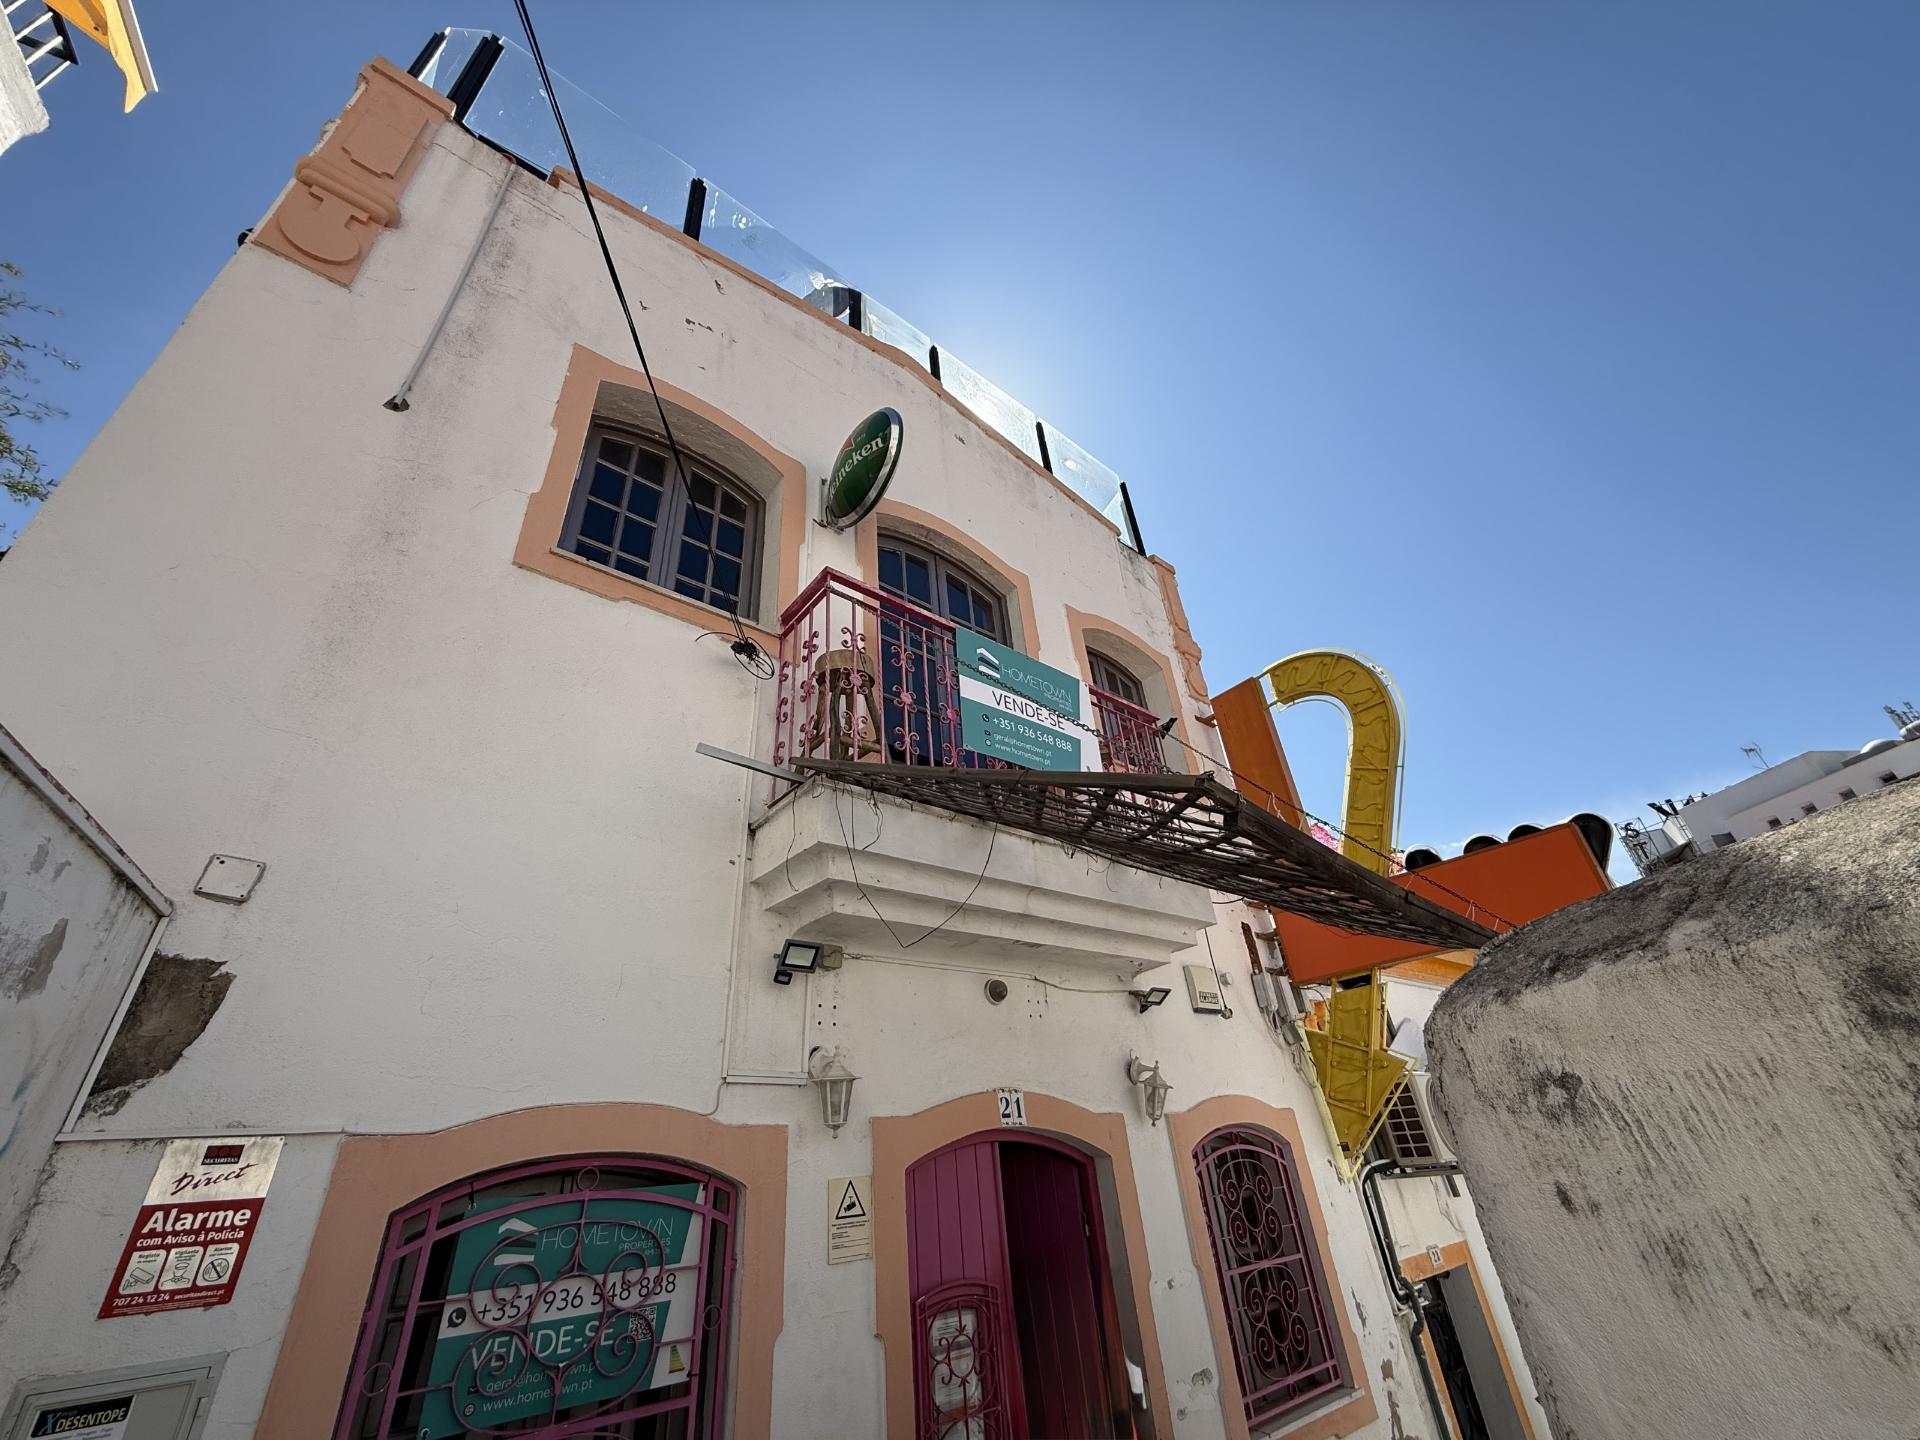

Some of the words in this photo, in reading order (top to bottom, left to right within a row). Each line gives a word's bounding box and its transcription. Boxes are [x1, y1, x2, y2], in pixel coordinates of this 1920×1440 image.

[1001, 663, 1072, 703] HOMETOWN
[992, 691, 1065, 730] VENDE-SE
[992, 717, 1016, 733] +351
[1018, 724, 1035, 739] 936
[1037, 731, 1054, 745] 548
[1055, 737, 1073, 752] 888
[993, 733, 1052, 757] geral@hometown.pt
[995, 743, 1051, 766] www.hometown.pt
[999, 1096, 1023, 1118] 21
[170, 1163, 259, 1195] Direct
[142, 1207, 252, 1234] Alarme
[136, 1236, 161, 1247] com
[163, 1233, 195, 1246] Aviso
[197, 1232, 205, 1242] à
[207, 1229, 244, 1242] Polícia
[112, 1298, 130, 1307] 707
[130, 1296, 144, 1304] 24
[146, 1295, 156, 1303] 12
[158, 1293, 171, 1301] 24
[543, 1286, 584, 1313] 936
[482, 1379, 593, 1412] www.homewn.pt
[54, 1407, 127, 1433] DESENTOPE
